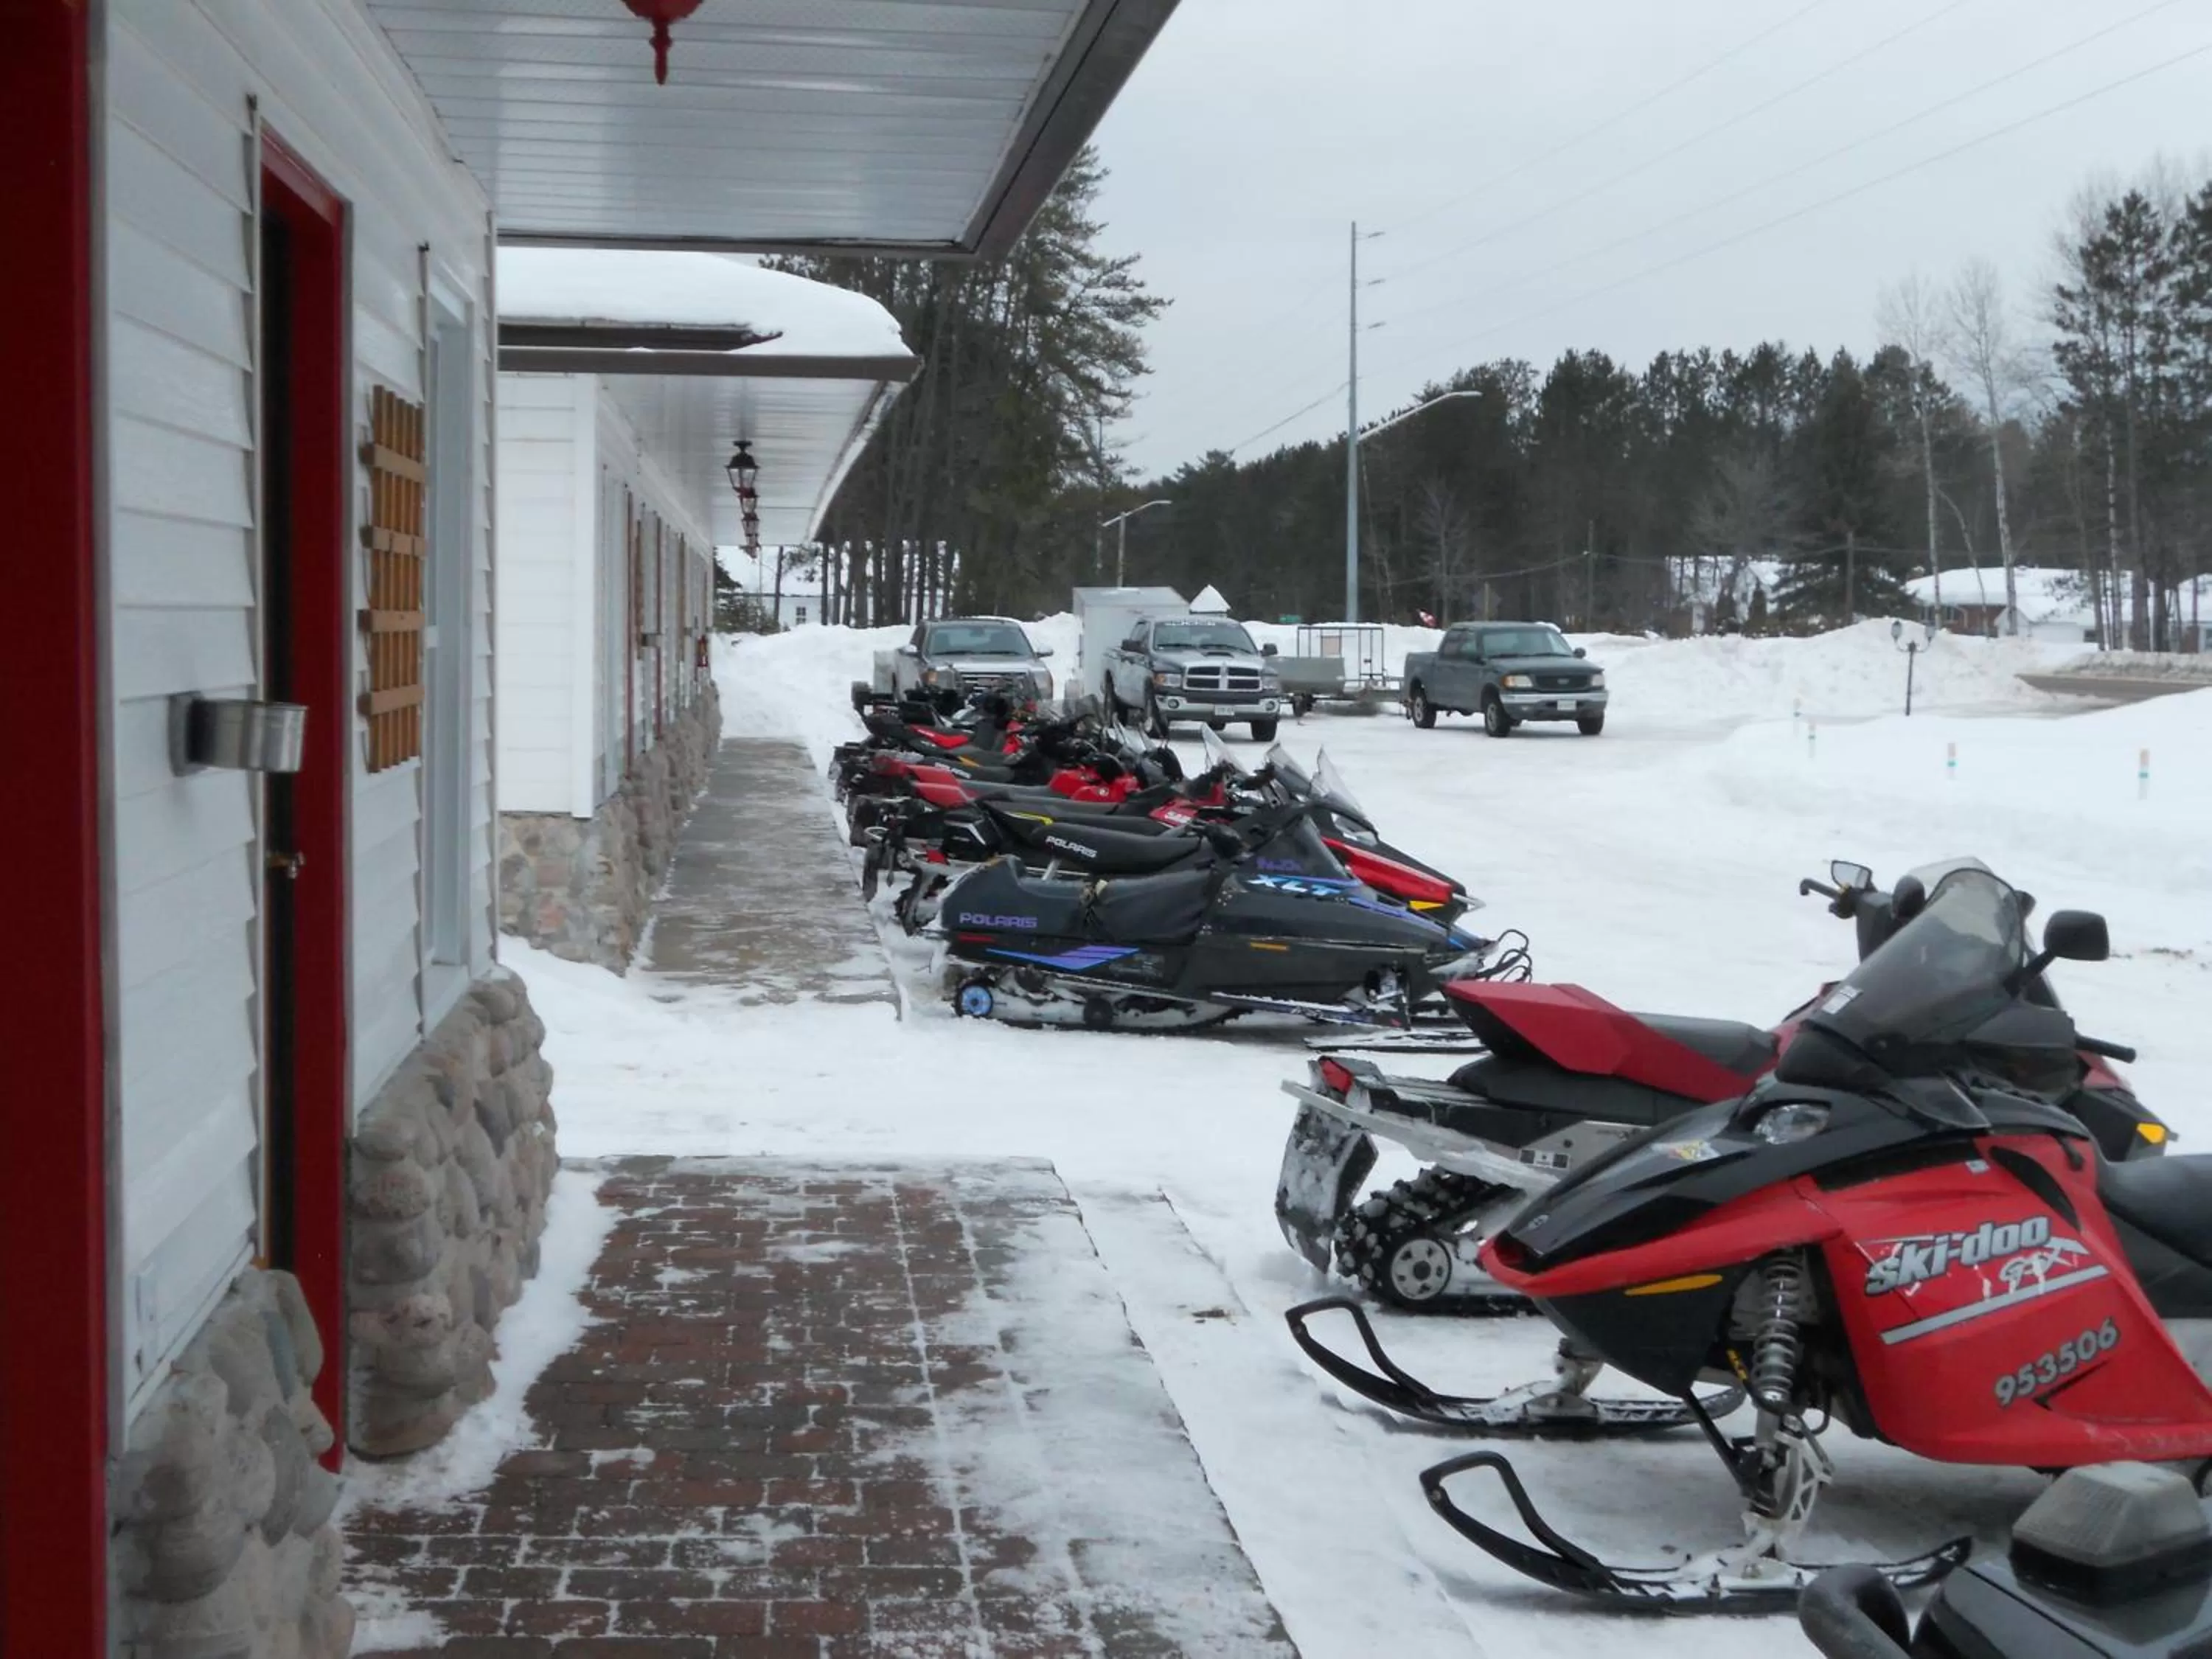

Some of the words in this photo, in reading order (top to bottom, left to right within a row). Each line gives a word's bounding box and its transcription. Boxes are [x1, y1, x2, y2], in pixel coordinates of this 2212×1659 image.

[1046, 835, 1097, 858] POLARIS
[1246, 874, 1341, 896] XLT
[959, 912, 1037, 928] POLARIS
[1994, 1316, 2121, 1408] 953506
